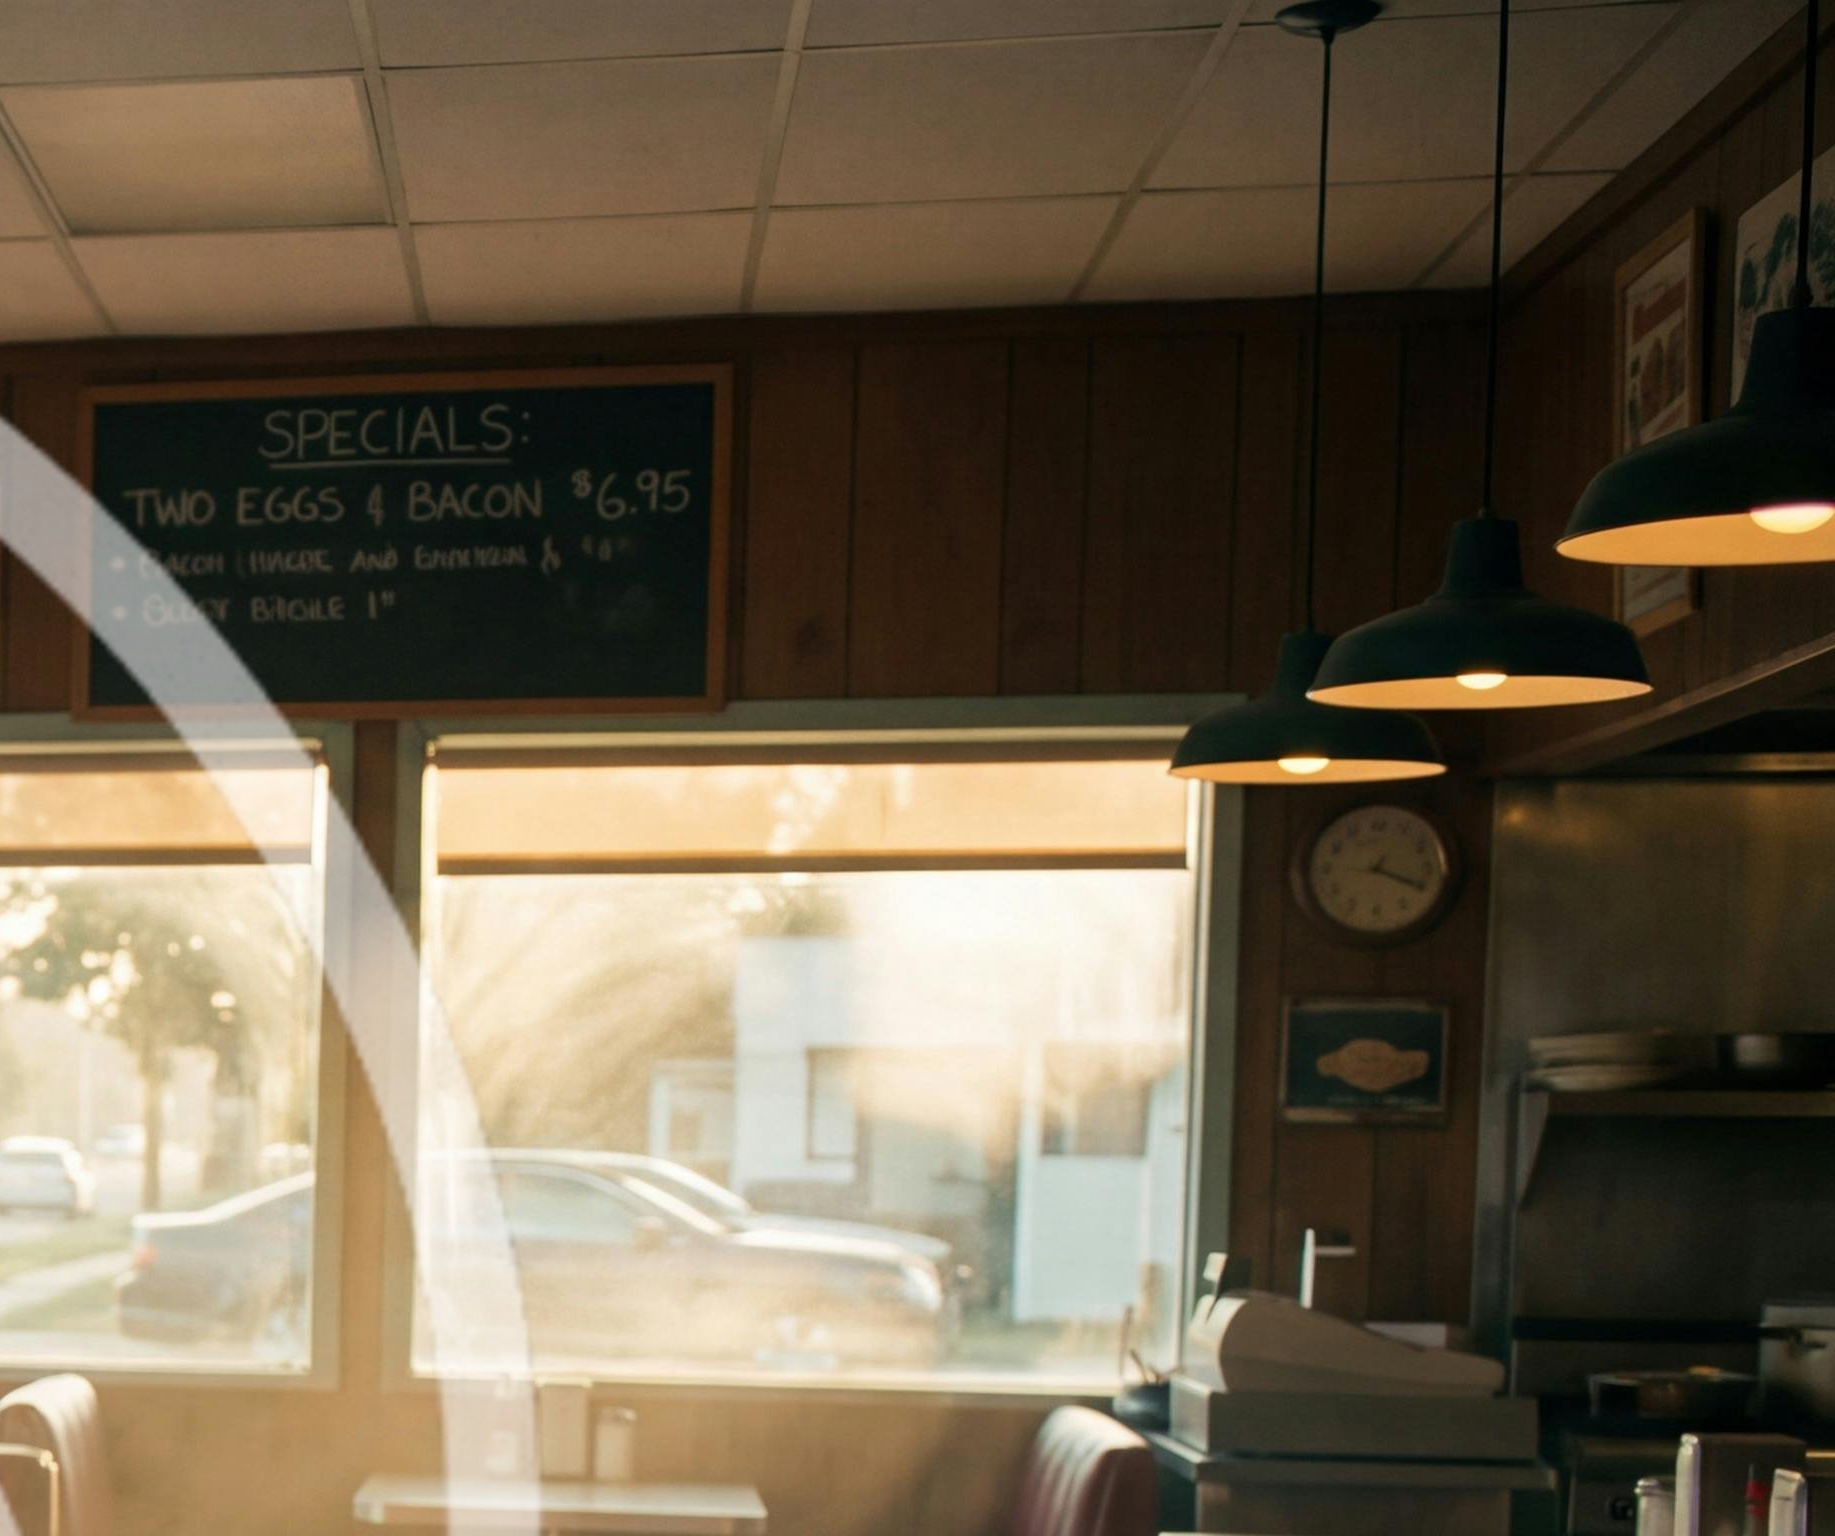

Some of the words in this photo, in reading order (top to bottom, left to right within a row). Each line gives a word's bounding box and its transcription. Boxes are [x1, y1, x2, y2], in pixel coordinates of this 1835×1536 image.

[258, 402, 530, 459] SPECIALS:
[122, 487, 216, 527] TWO
[237, 485, 346, 527] EGGS
[407, 479, 543, 523] BACON
[571, 468, 691, 520] $6.95
